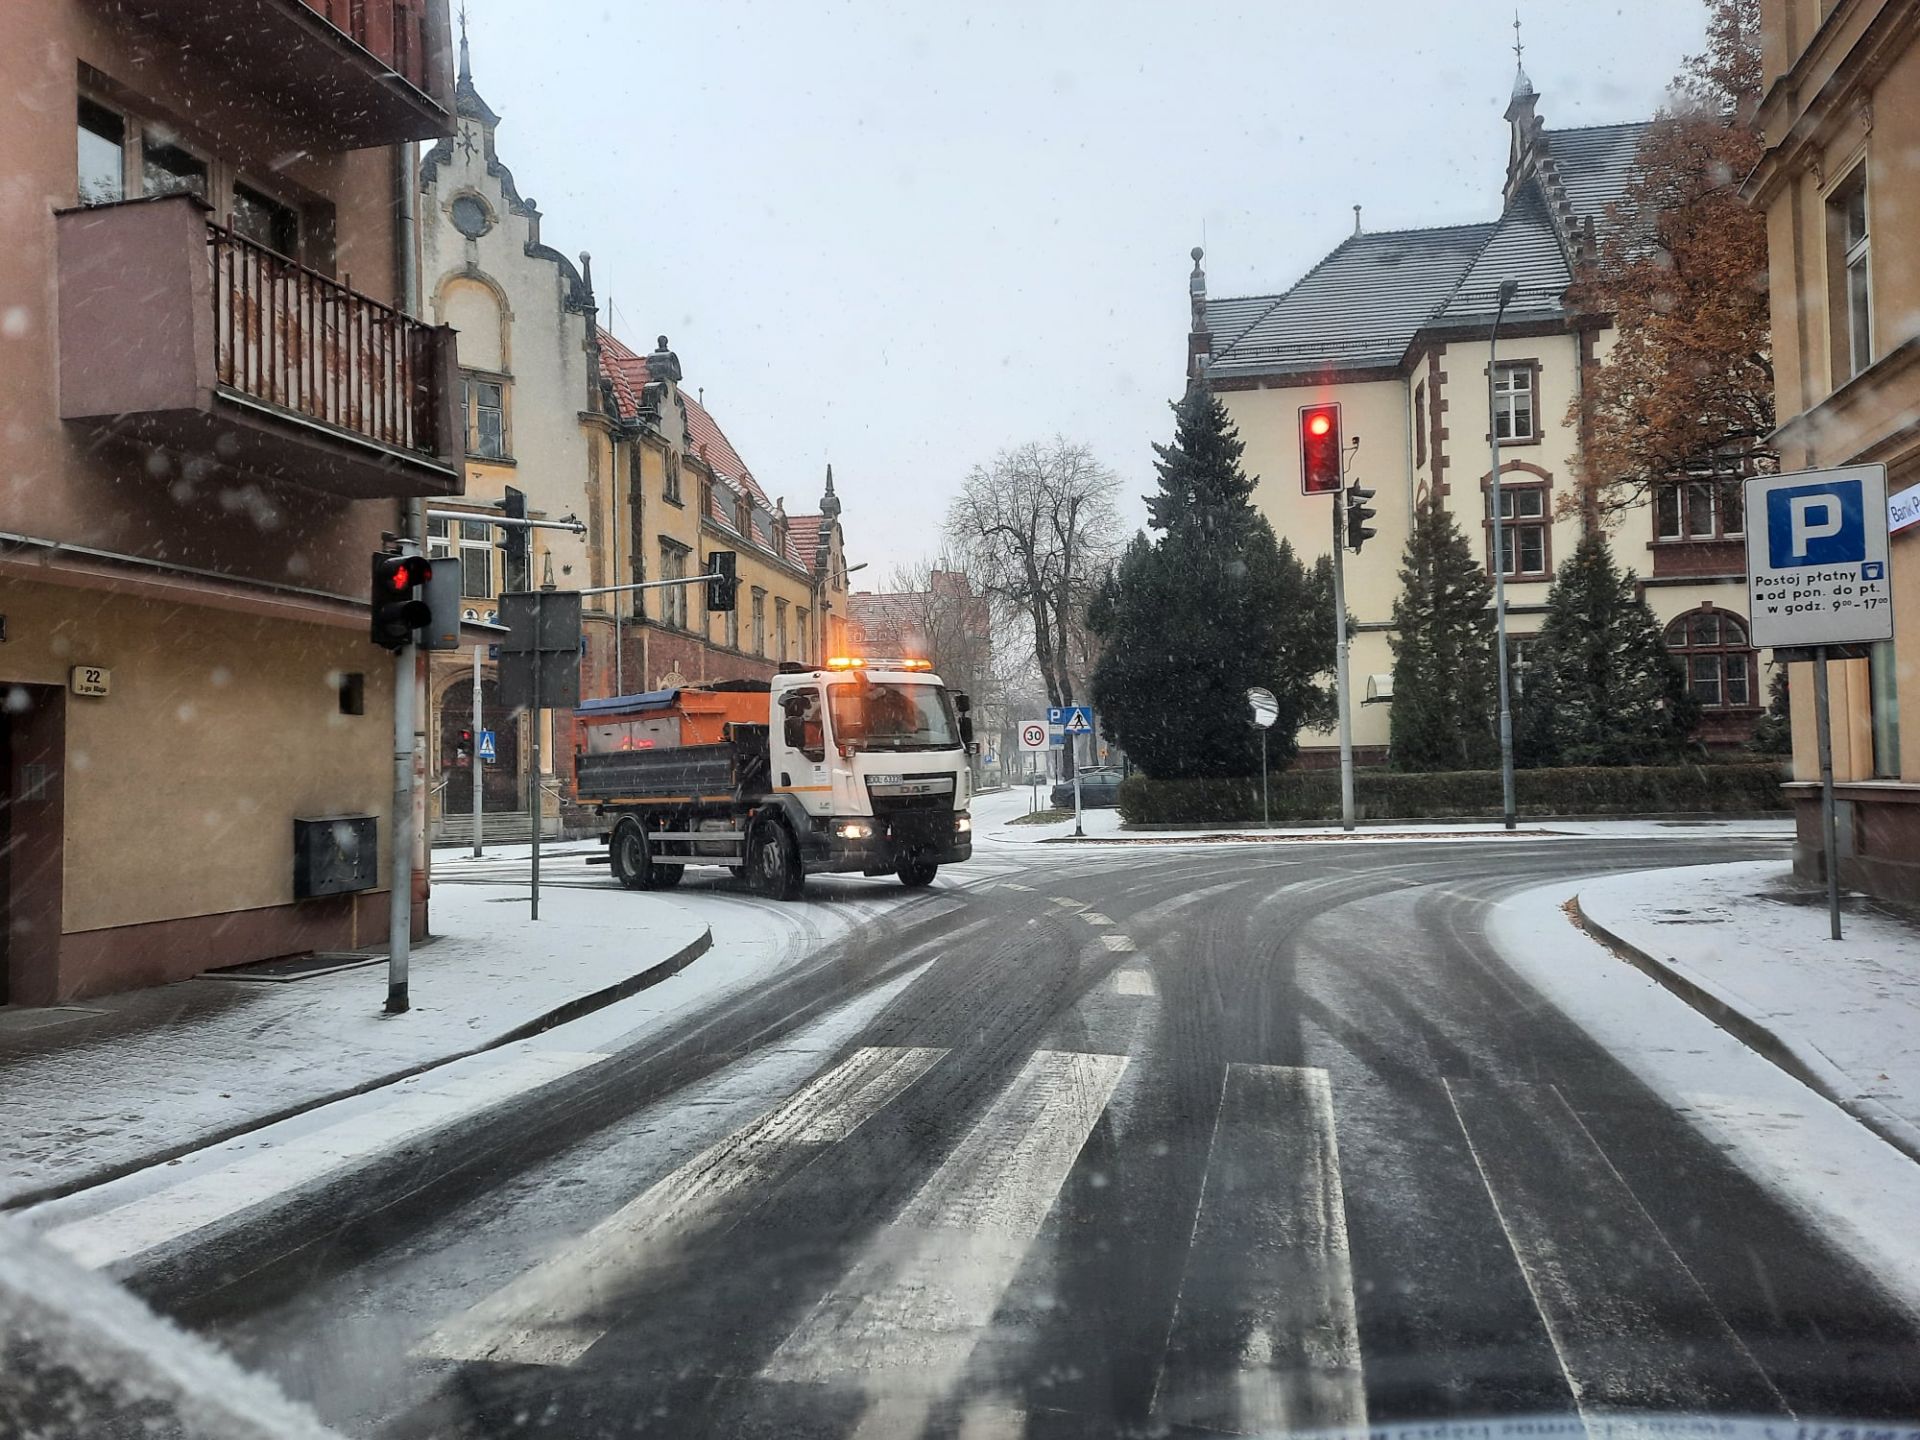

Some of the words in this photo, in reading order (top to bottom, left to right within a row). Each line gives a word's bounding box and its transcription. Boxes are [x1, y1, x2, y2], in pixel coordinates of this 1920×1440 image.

[1790, 493, 1843, 558] P
[1755, 573, 1800, 587] Postoj
[1807, 571, 1857, 586] płatny
[1767, 588, 1786, 600] od
[1793, 588, 1827, 601] pon.
[1833, 585, 1853, 596] do
[1860, 583, 1881, 597] pt.
[1767, 605, 1778, 614] w
[1784, 601, 1826, 616] godz.
[86, 669, 101, 684] 22
[1050, 709, 1061, 723] P
[1027, 730, 1041, 741] 30
[900, 785, 931, 794] DAF
